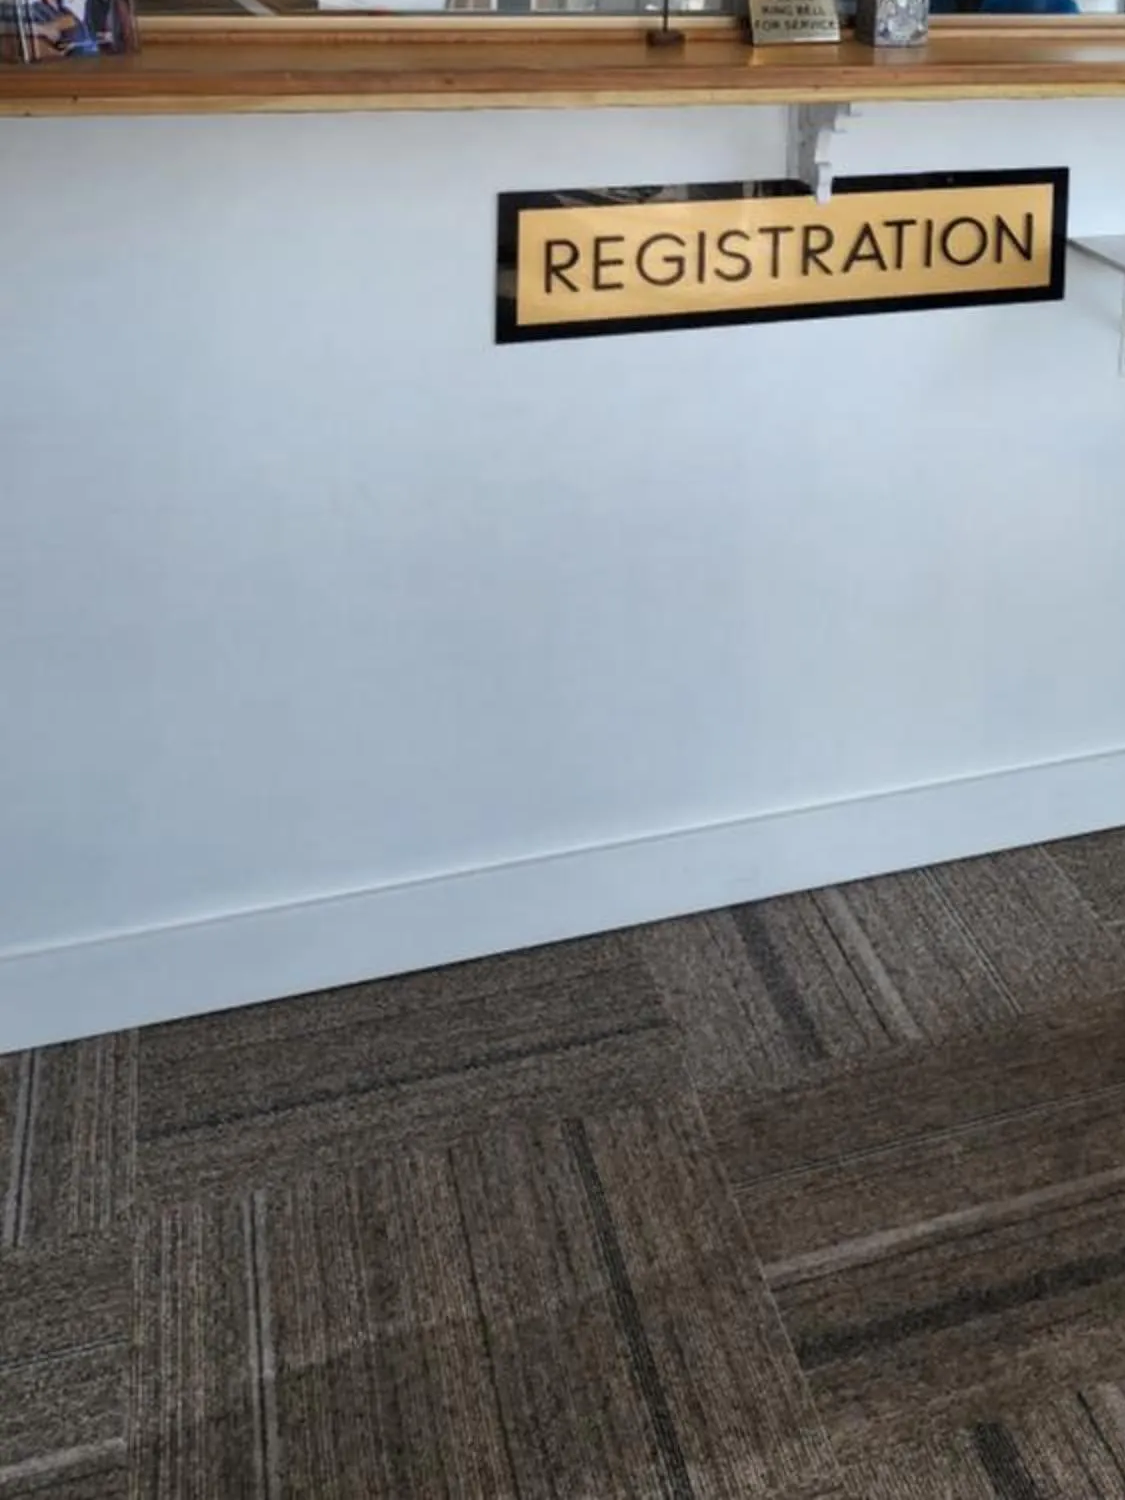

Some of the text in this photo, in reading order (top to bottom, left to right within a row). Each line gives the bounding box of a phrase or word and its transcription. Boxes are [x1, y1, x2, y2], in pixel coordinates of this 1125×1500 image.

[761, 4, 825, 15] RING BELL
[754, 18, 835, 30] FOR SERVICE
[543, 211, 1035, 294] REGISTRATION
